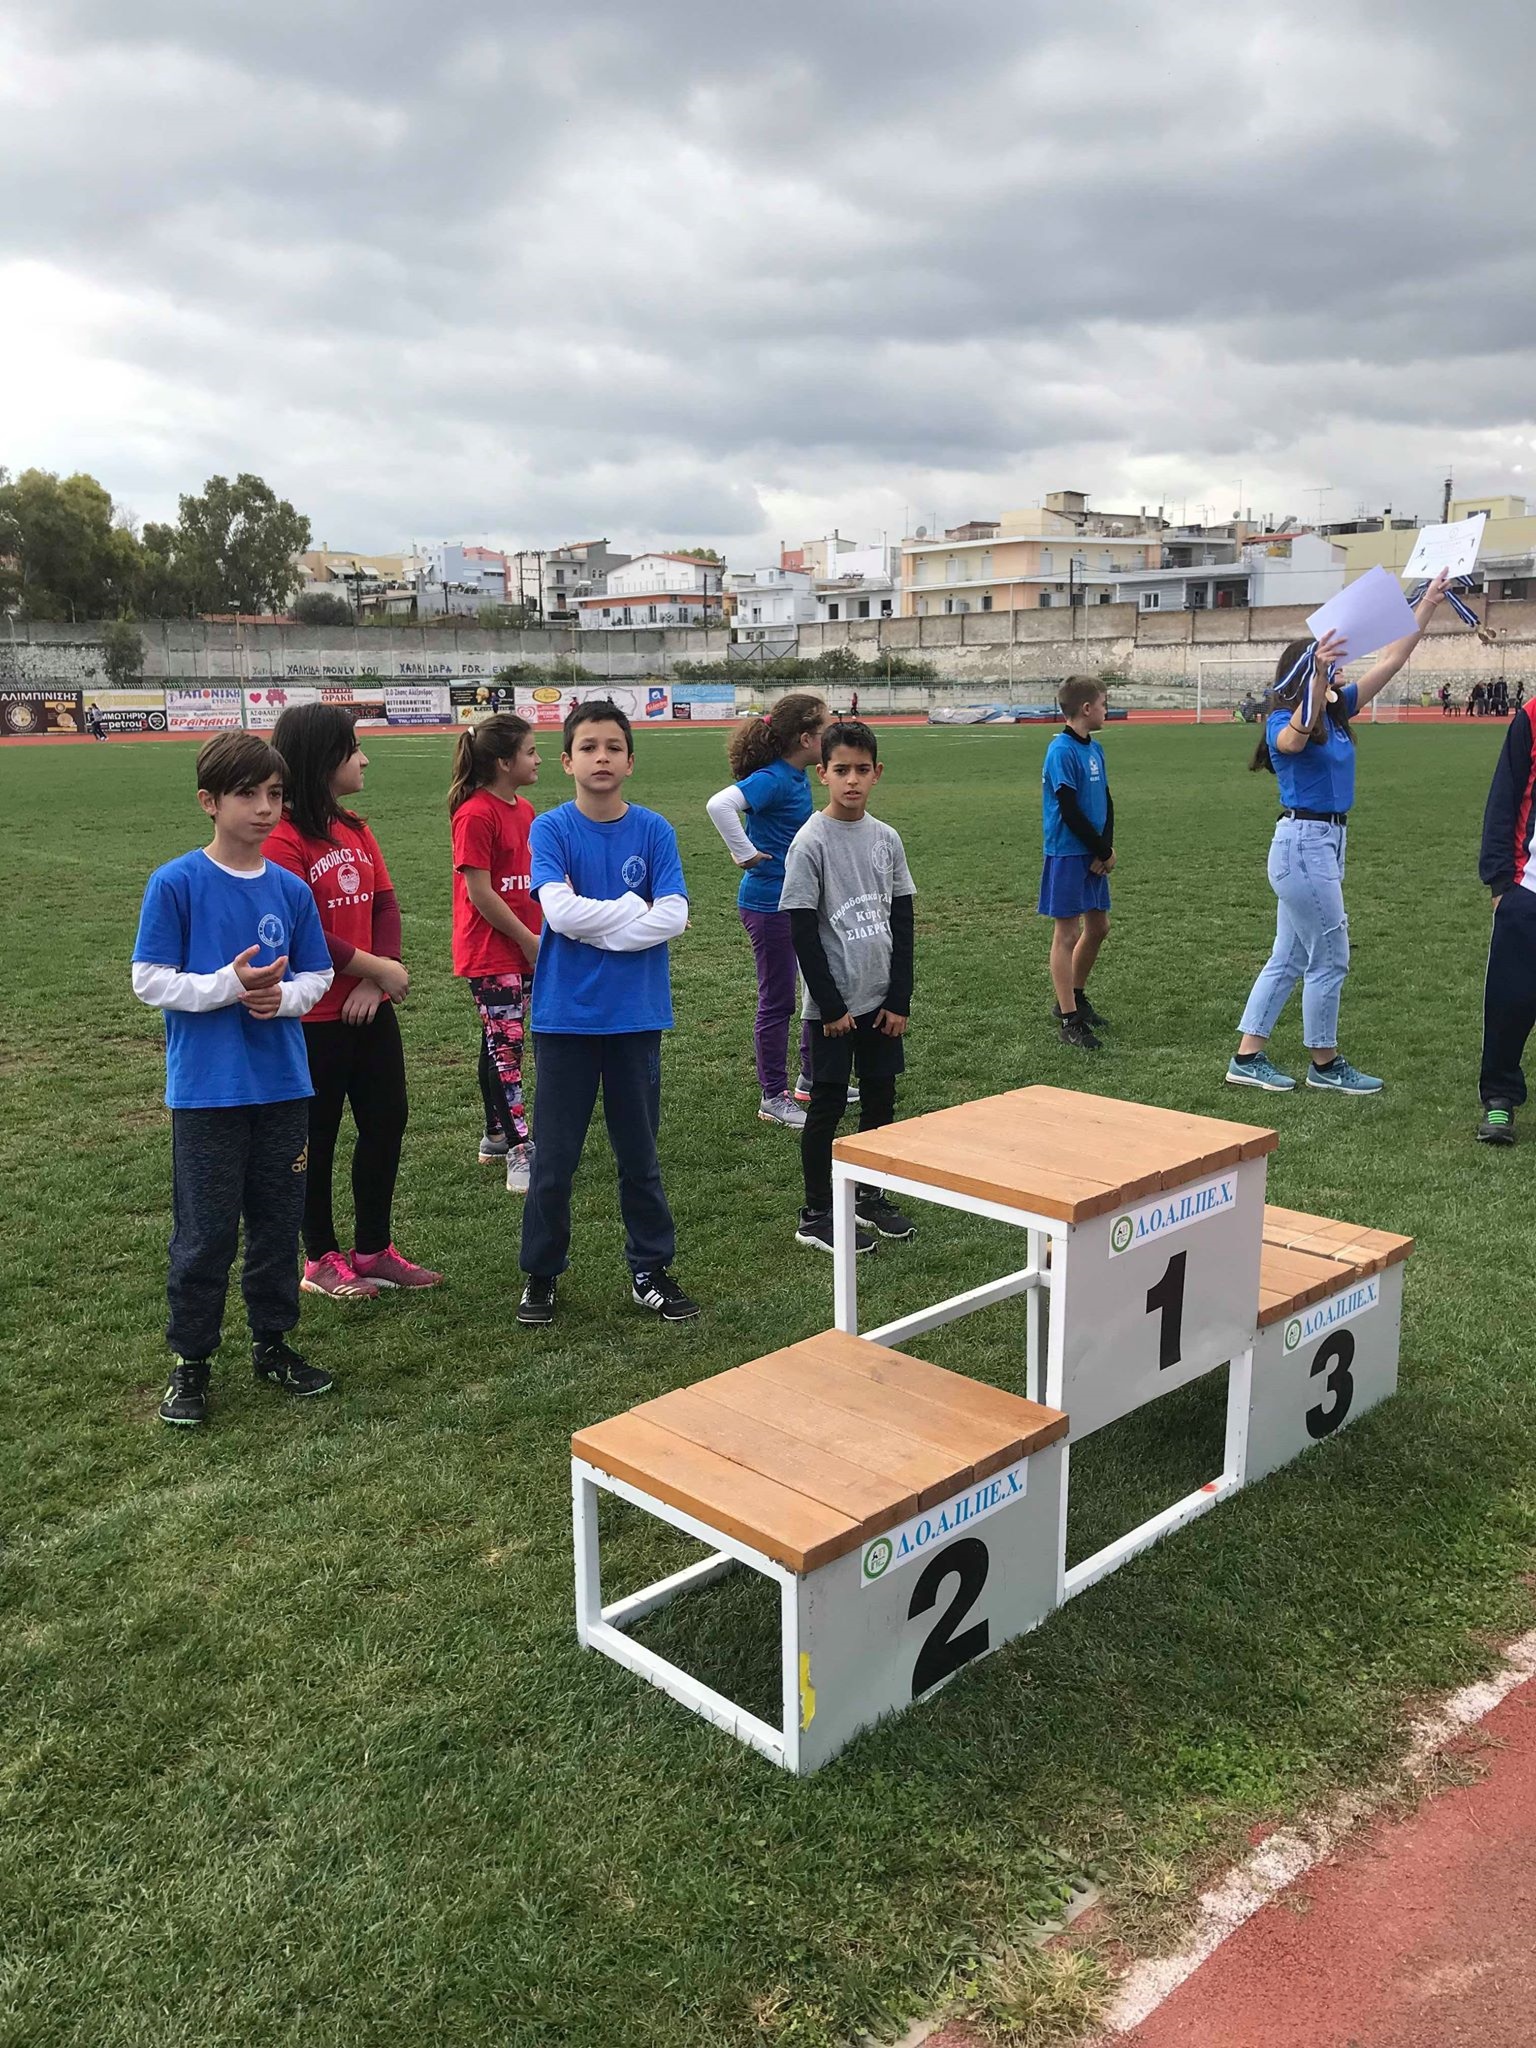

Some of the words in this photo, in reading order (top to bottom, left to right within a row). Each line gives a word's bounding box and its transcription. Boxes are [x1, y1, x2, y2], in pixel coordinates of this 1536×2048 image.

[321, 694, 353, 702] ΘΡΑΚΗ
[500, 875, 531, 892] ΣΤΙΒ
[1146, 1250, 1187, 1371] 1
[1306, 1329, 1355, 1439] 3
[907, 1537, 990, 1701] 2
